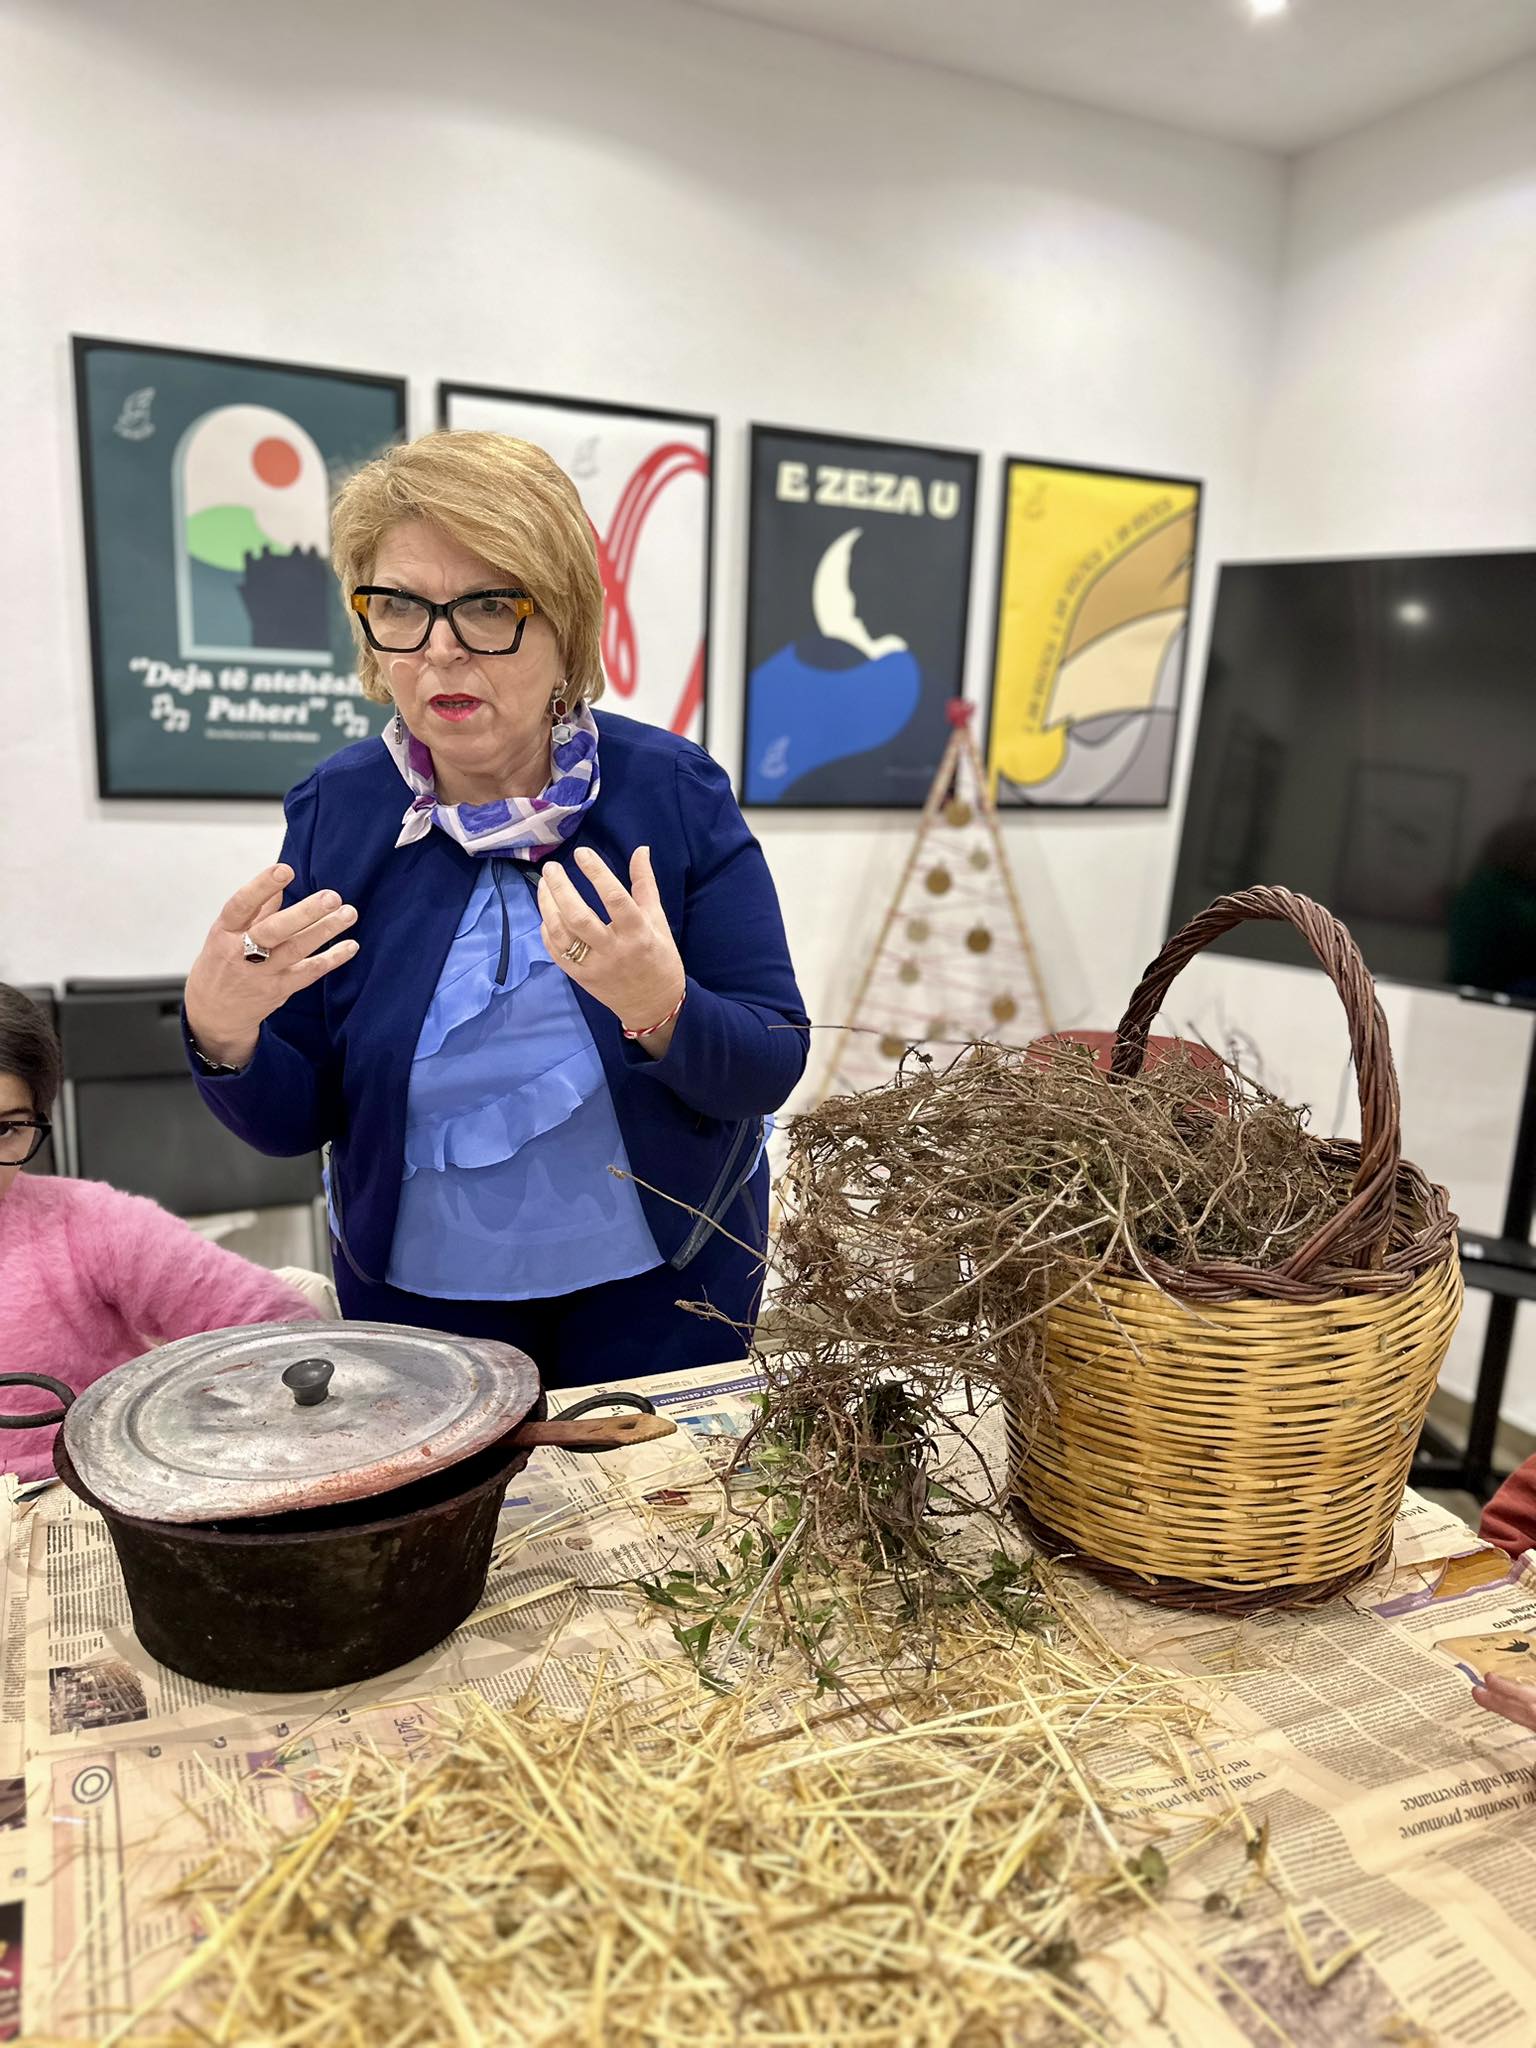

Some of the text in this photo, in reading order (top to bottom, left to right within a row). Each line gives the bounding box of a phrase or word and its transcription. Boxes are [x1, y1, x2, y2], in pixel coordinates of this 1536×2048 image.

[776, 460, 960, 520] E ZEZA U
[1400, 1778, 1472, 1812] governance
[1470, 1774, 1502, 1795] sulla
[1399, 1807, 1463, 1840] promuove
